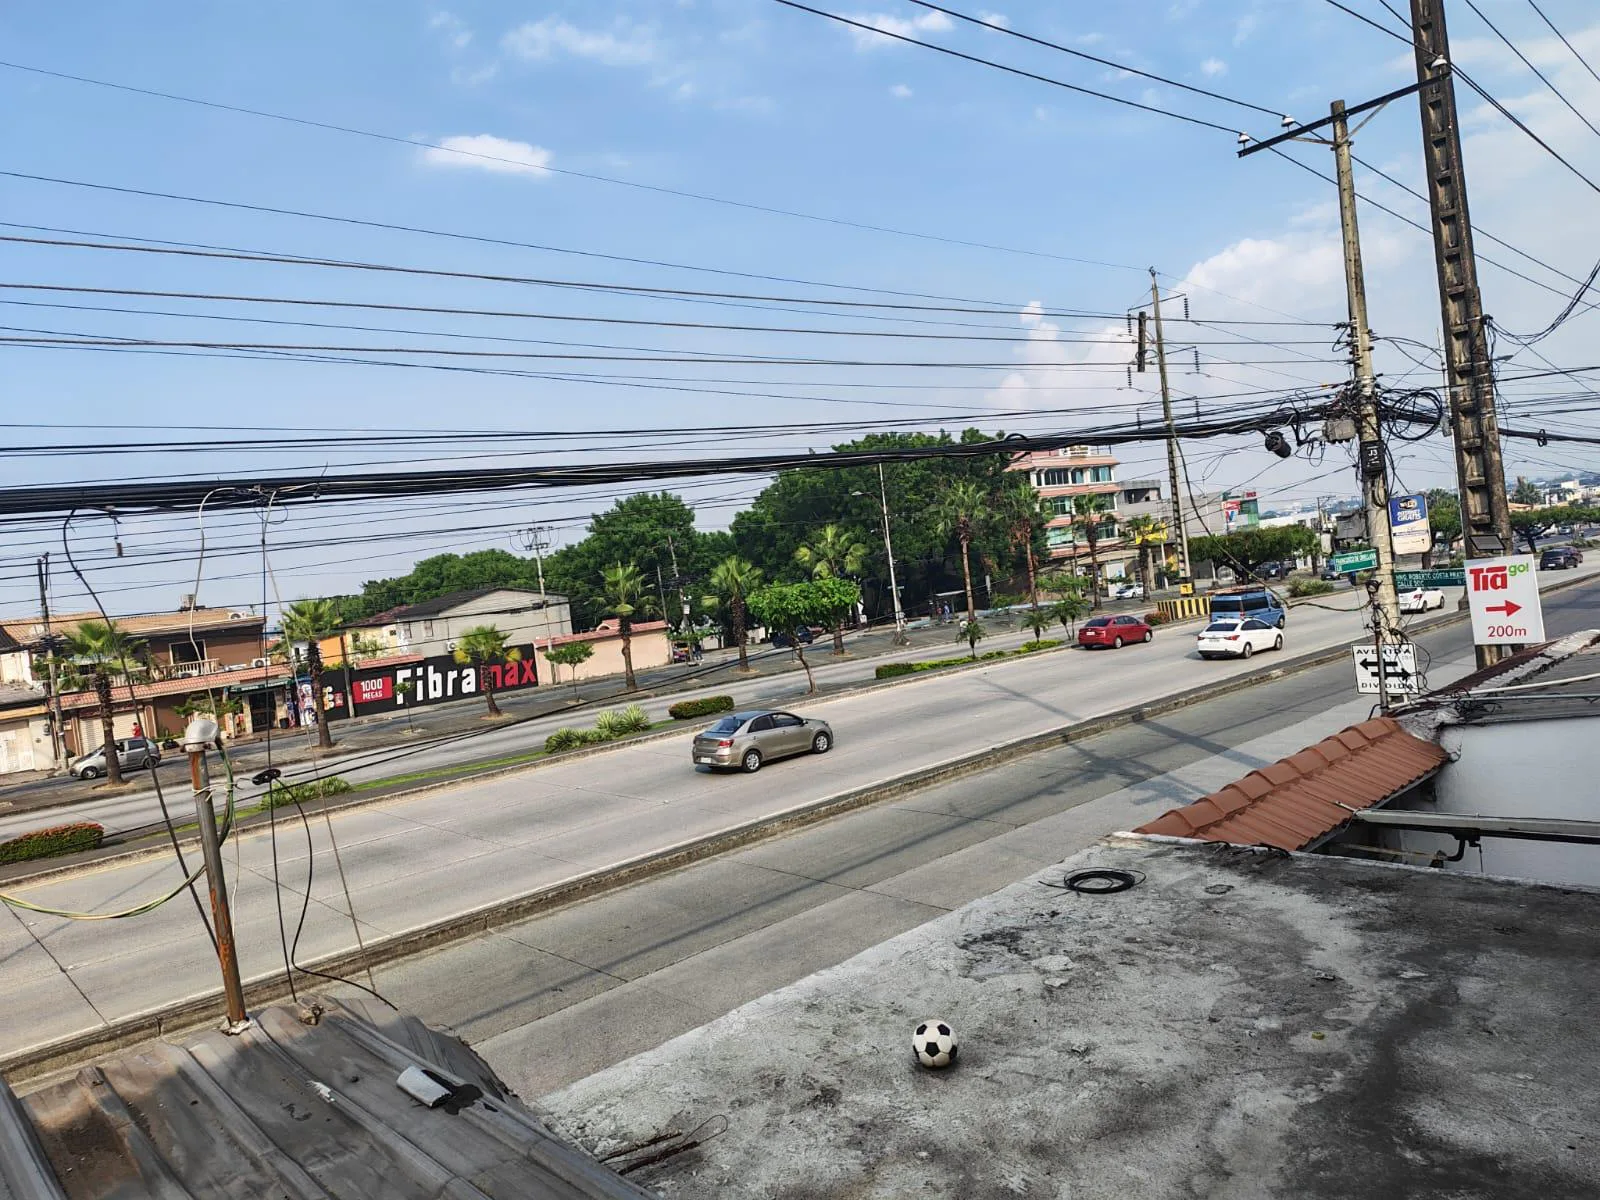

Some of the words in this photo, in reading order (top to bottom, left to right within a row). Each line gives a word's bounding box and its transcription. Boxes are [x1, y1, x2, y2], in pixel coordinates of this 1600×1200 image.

[1508, 563, 1529, 577] go!
[1488, 625, 1527, 638] 200m
[361, 678, 383, 691] 1000
[1361, 682, 1413, 690] DIVDIDA
[362, 691, 383, 700] MEGAS
